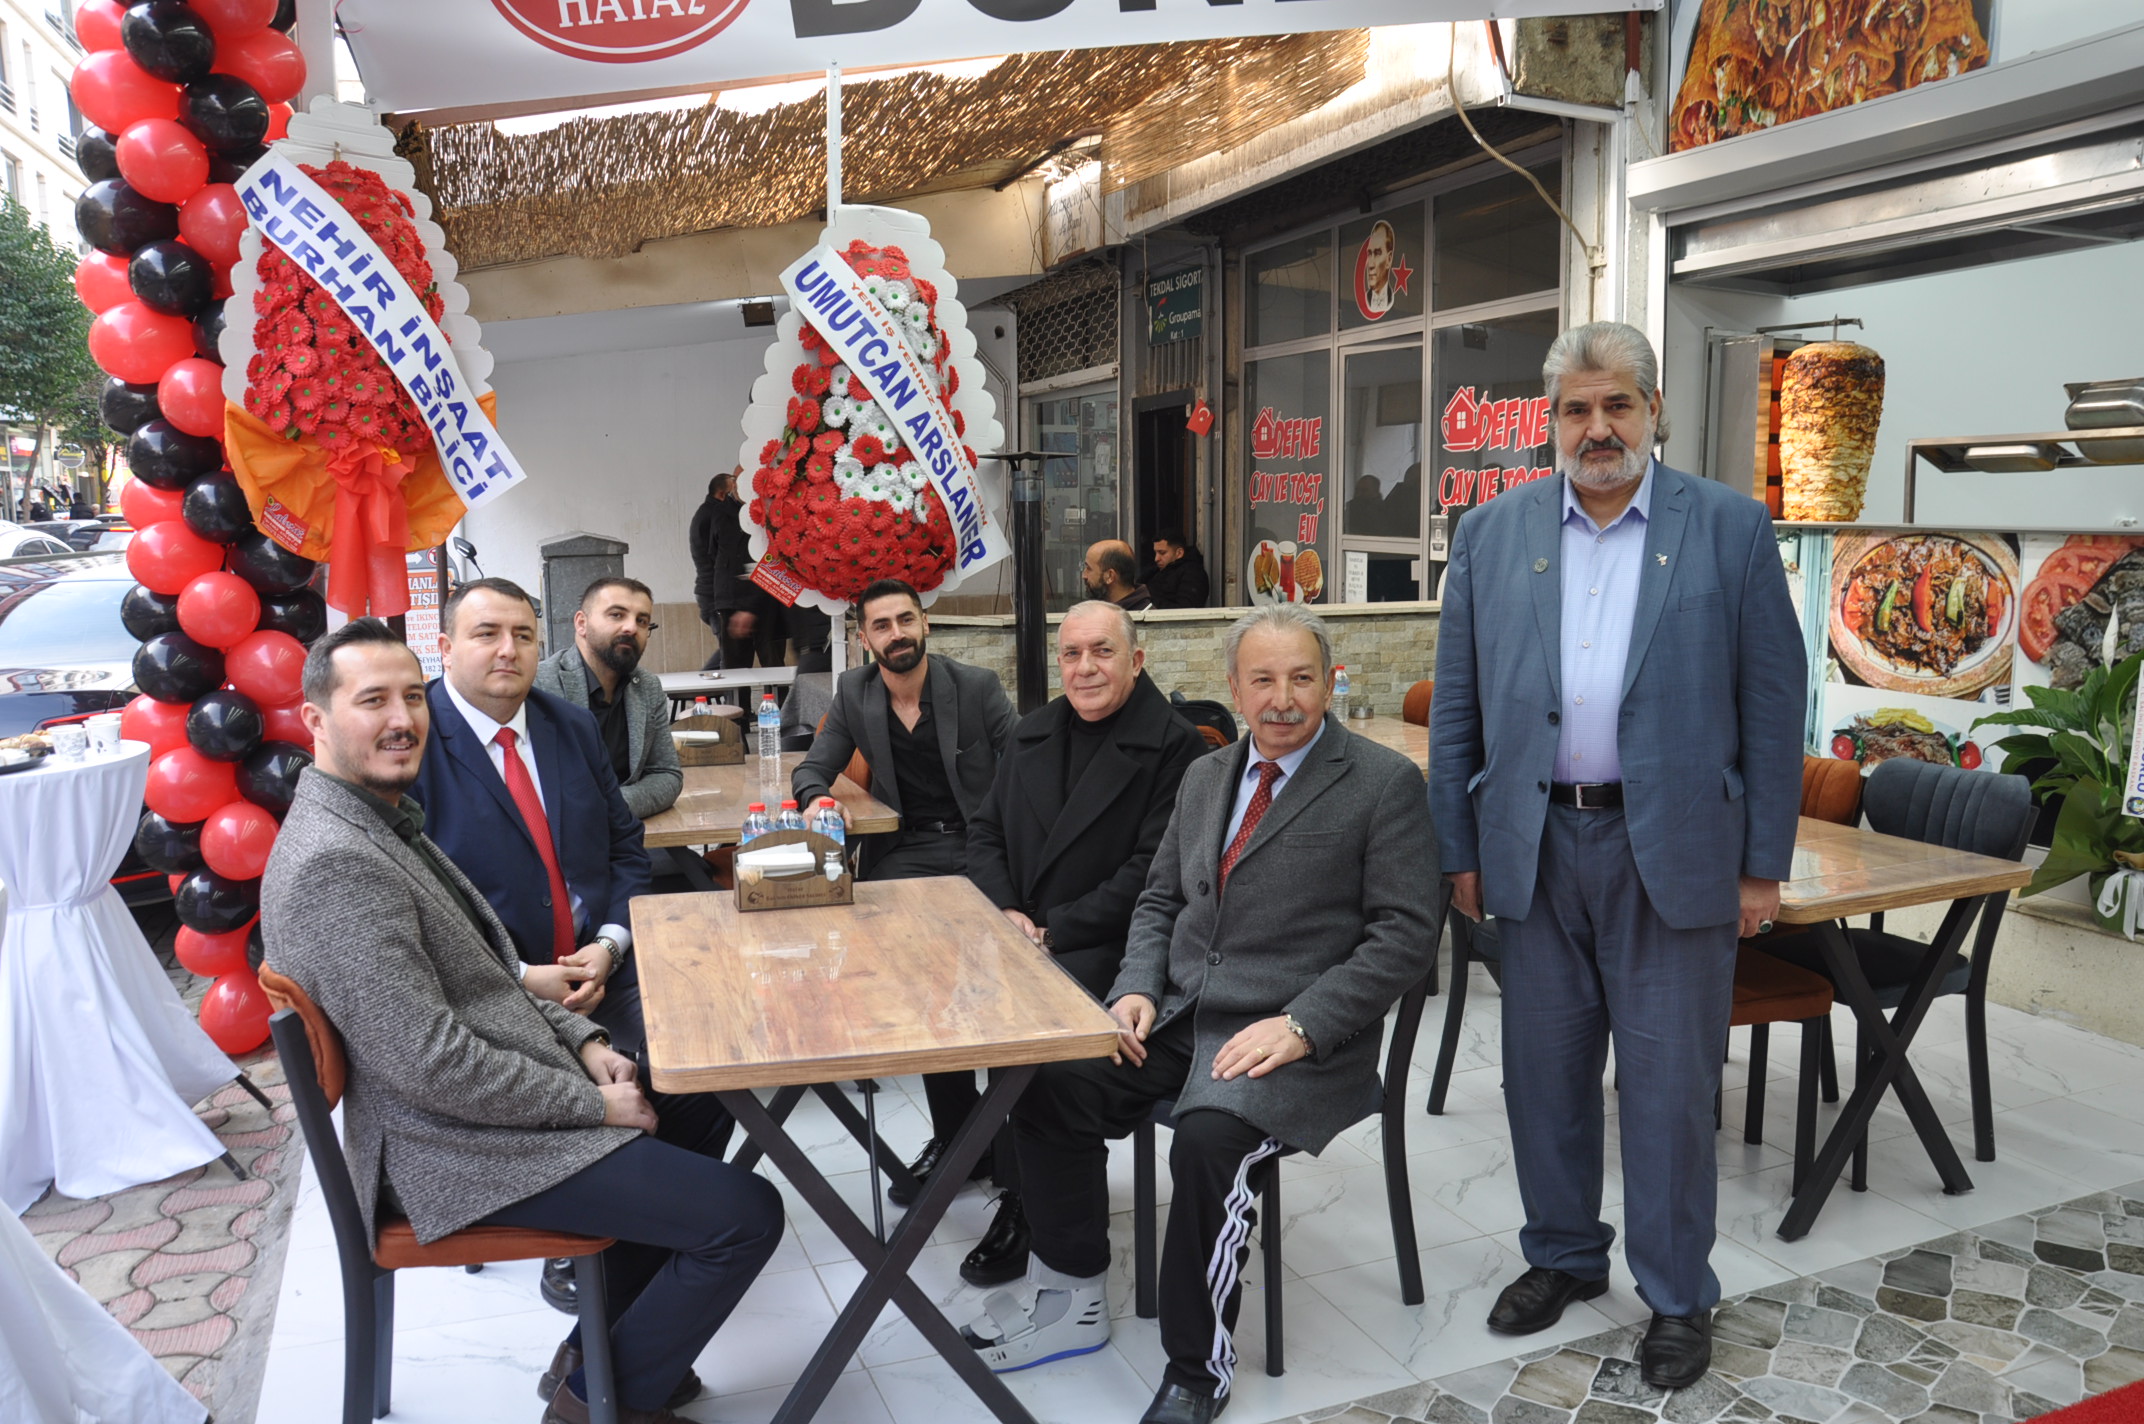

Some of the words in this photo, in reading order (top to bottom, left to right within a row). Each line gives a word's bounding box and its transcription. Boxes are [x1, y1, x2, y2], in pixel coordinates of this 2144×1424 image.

[1175, 269, 1203, 290] SİGORT
[259, 168, 396, 312] NEHİR
[400, 316, 512, 480] İNŞAAT
[1169, 308, 1202, 324] Groupama
[240, 186, 406, 366] BURHAN
[409, 374, 488, 500] BİLİCİ
[794, 260, 918, 411] UMUTCAN
[905, 411, 987, 569] ARSLANER
[850, 281, 881, 318] YENİ
[881, 318, 895, 338] İŞ
[898, 339, 936, 407] YERİNİZ
[935, 409, 967, 471] HAYIRLI
[967, 475, 988, 526] OLSUN
[1273, 416, 1322, 460] DEFNE
[1474, 396, 1551, 452] DEFNE
[1250, 471, 1273, 509] ÇAY
[1273, 472, 1289, 503] VE
[1290, 471, 1322, 504] TOST
[1438, 467, 1476, 515] ÇAY
[1477, 467, 1500, 505] VE
[410, 589, 440, 609] TİŞİ
[416, 612, 439, 622] İKİNC
[407, 622, 441, 631] TELOFO
[418, 631, 439, 641] SATI
[419, 656, 442, 664] SEYHA
